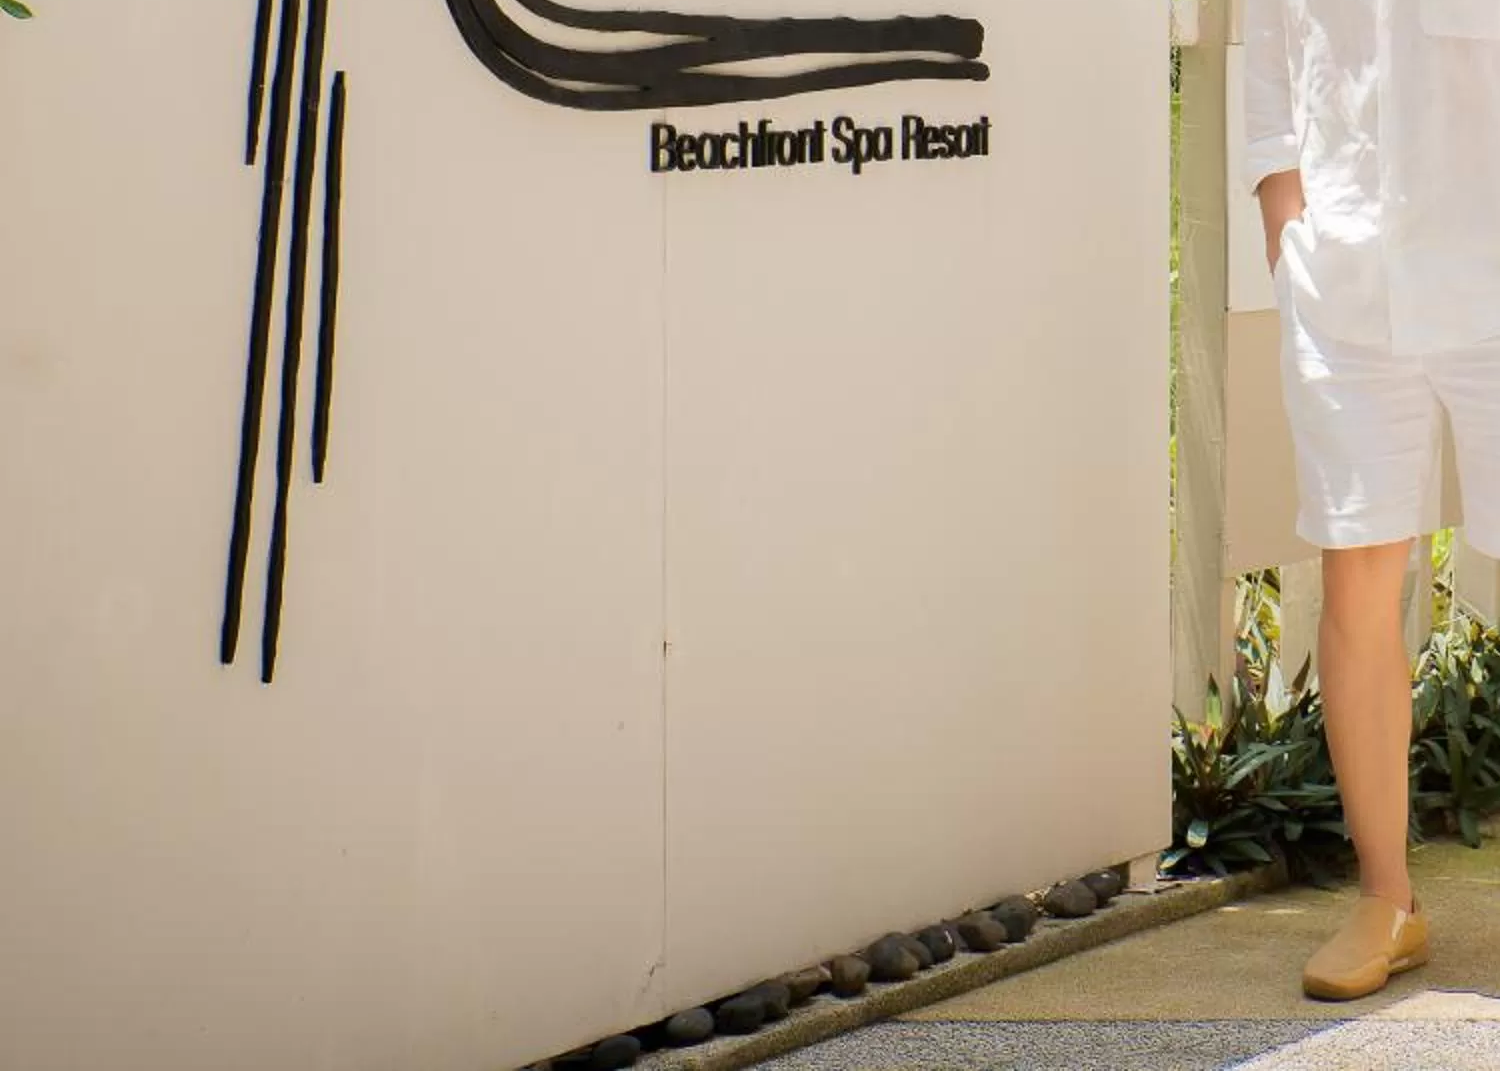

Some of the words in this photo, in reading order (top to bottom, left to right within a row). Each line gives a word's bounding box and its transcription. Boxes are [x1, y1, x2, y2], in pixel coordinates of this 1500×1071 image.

[650, 119, 828, 173] Beachfront
[831, 116, 894, 176] Spa
[901, 115, 993, 161] Resort
